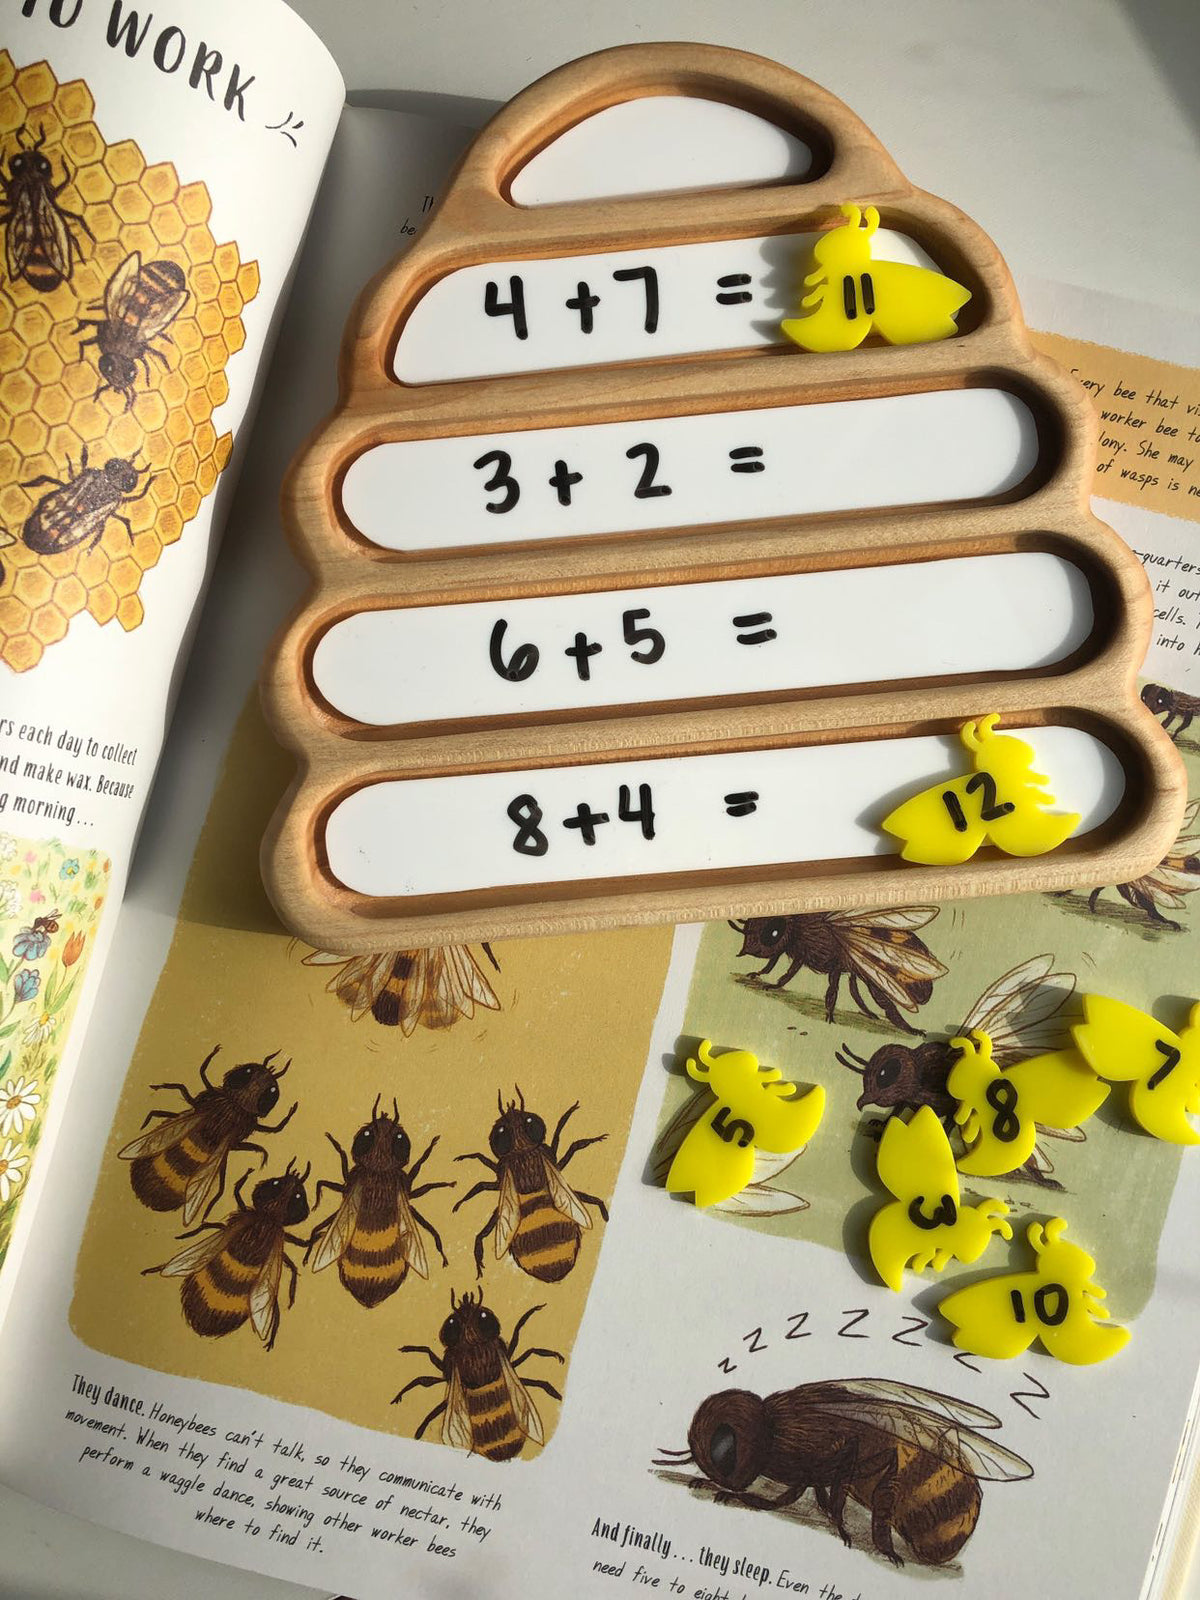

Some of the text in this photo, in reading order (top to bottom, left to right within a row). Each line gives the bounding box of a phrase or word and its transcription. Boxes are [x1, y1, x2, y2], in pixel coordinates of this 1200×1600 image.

[106, 0, 256, 121] WORK
[843, 272, 875, 320] 11
[1070, 368, 1105, 398] ery
[1113, 380, 1137, 400] bee
[1145, 389, 1179, 409] that
[1100, 410, 1147, 429] worker
[1155, 417, 1179, 437] bee
[1096, 458, 1115, 473] of
[1120, 468, 1159, 491] wasps
[1167, 478, 1180, 491] is
[1136, 440, 1160, 460] She
[1167, 453, 1194, 473] may
[1156, 579, 1170, 593] it
[1153, 606, 1186, 626] cells.
[1156, 634, 1185, 651] into
[18, 724, 53, 746] each
[57, 730, 83, 758] day
[86, 737, 99, 757] to
[101, 743, 138, 766] collect
[23, 761, 63, 785] make
[66, 771, 92, 792] wax.
[96, 774, 135, 799] Because
[942, 771, 1015, 832] 12
[1146, 1038, 1182, 1091] 7
[711, 1106, 756, 1149] 5
[985, 1078, 1019, 1143] 8
[907, 1193, 957, 1231] 3
[1010, 1282, 1069, 1327] 10
[71, 1374, 502, 1511] They dance. Honeybees can't talk, so they communicate with
[65, 1408, 492, 1543] movement. When they find a great source of nectar, they
[79, 1445, 457, 1558] perform a waggle dance, showing other worker bees
[194, 1506, 323, 1553] where to find it.
[591, 1517, 620, 1542] And
[699, 1546, 730, 1576] they
[733, 1556, 772, 1587] sleep.
[777, 1570, 810, 1594] Even
[819, 1584, 843, 1600] the
[592, 1558, 627, 1578] need
[633, 1565, 660, 1588] five
[670, 1577, 685, 1595] to
